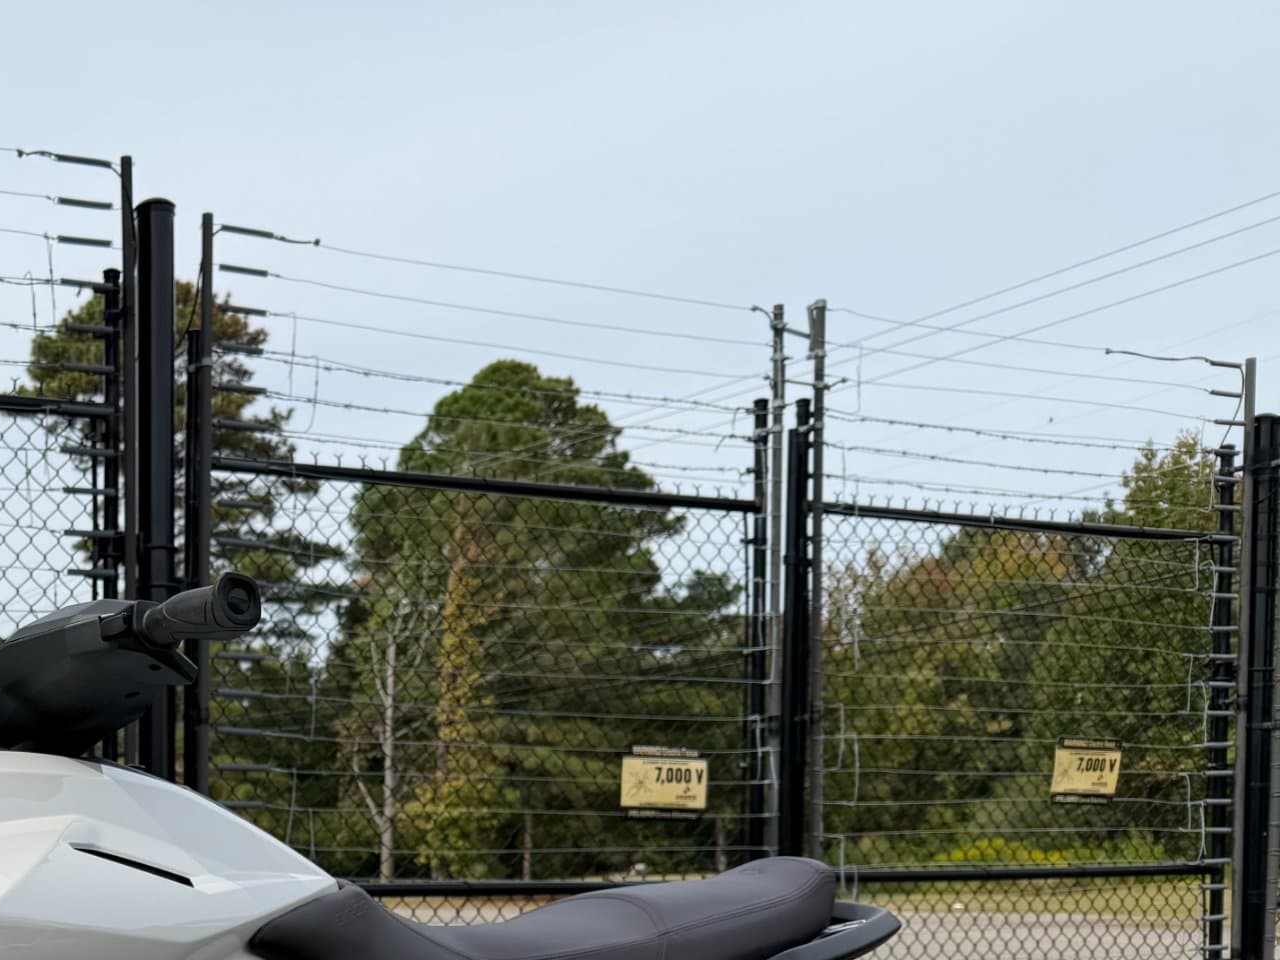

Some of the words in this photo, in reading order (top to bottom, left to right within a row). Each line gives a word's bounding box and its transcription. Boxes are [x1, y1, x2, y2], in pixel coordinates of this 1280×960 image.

[1077, 758, 1106, 773] 7,000
[1109, 758, 1117, 773] V
[656, 767, 691, 785] 7,000
[696, 769, 704, 784] V
